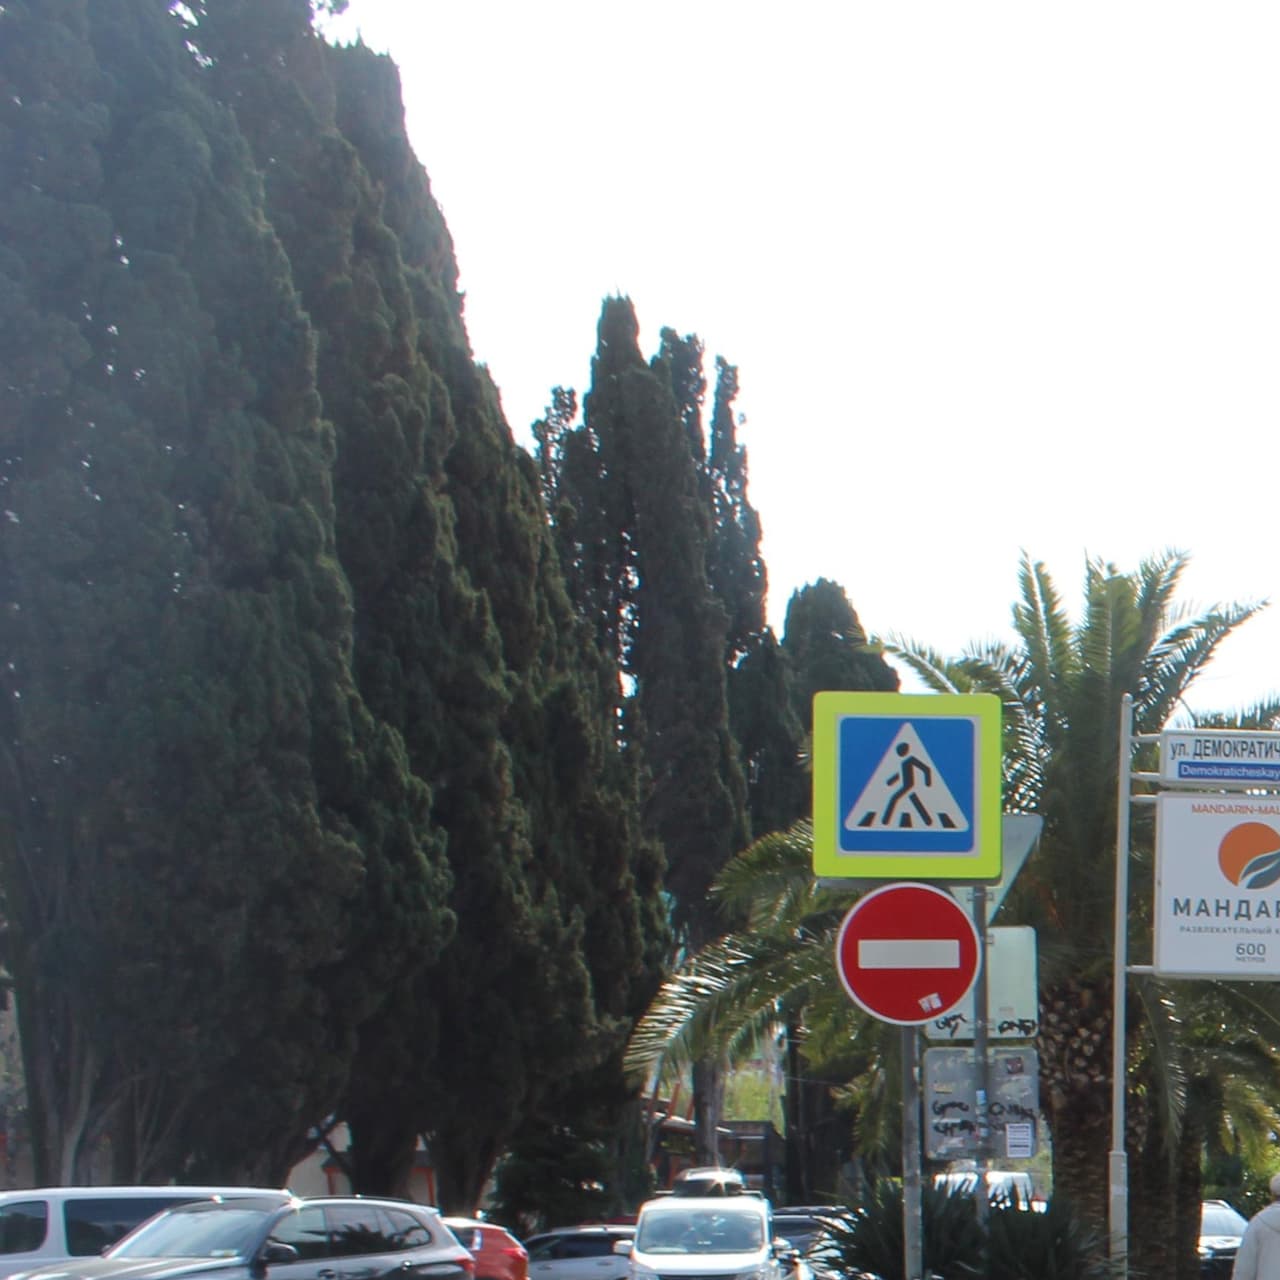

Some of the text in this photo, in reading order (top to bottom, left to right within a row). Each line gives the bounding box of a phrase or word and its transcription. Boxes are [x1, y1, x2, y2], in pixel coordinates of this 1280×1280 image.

[1170, 744, 1190, 760] ул.
[1179, 925, 1273, 936] РАЗВЛЕКАТЕЛЬНЫЙ
[1235, 942, 1267, 956] 600
